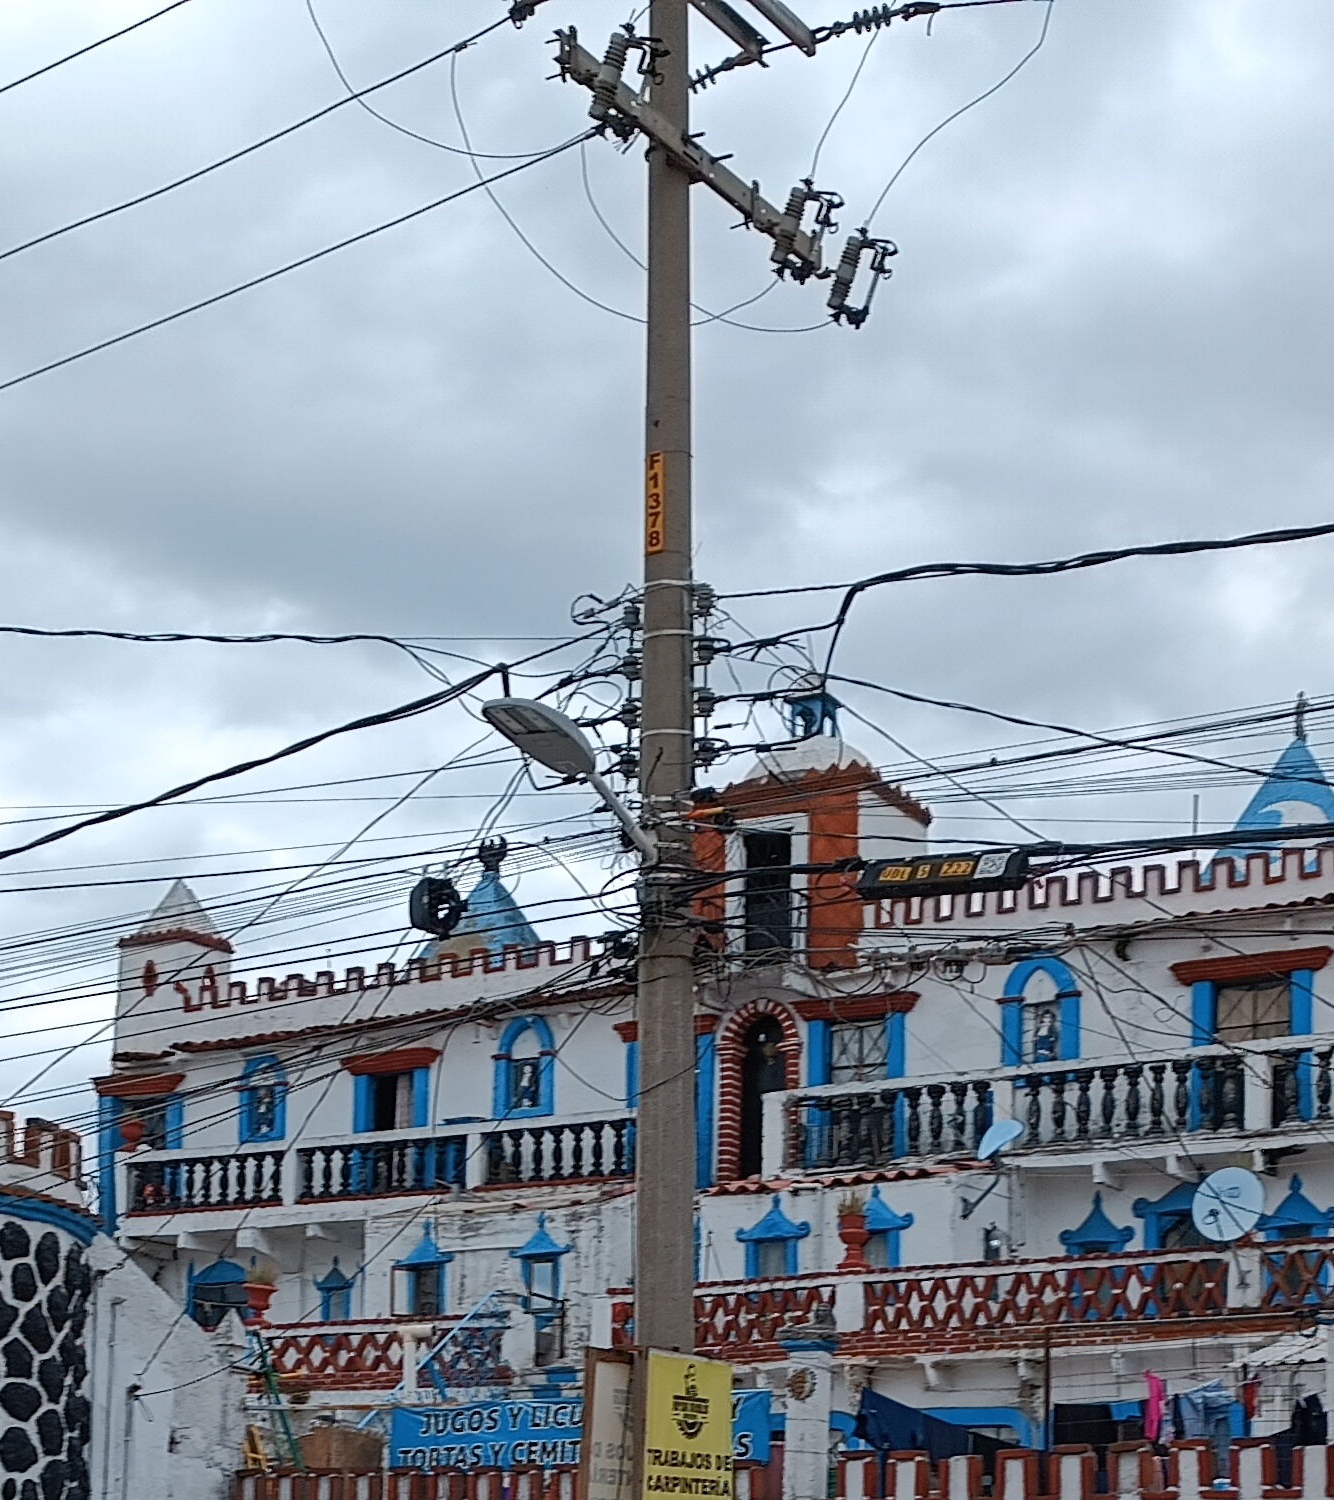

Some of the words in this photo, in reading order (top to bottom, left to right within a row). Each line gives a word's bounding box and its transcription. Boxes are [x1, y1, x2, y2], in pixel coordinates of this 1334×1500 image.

[648, 452, 662, 548] F1378
[419, 1408, 501, 1436] JUGOS
[505, 1404, 525, 1430] Y
[398, 1442, 485, 1470] TORTAS
[487, 1441, 508, 1466] Y
[647, 1448, 712, 1470] TRABAJOS
[715, 1455, 732, 1471] DE
[647, 1475, 730, 1496] CARPINTERÍA
